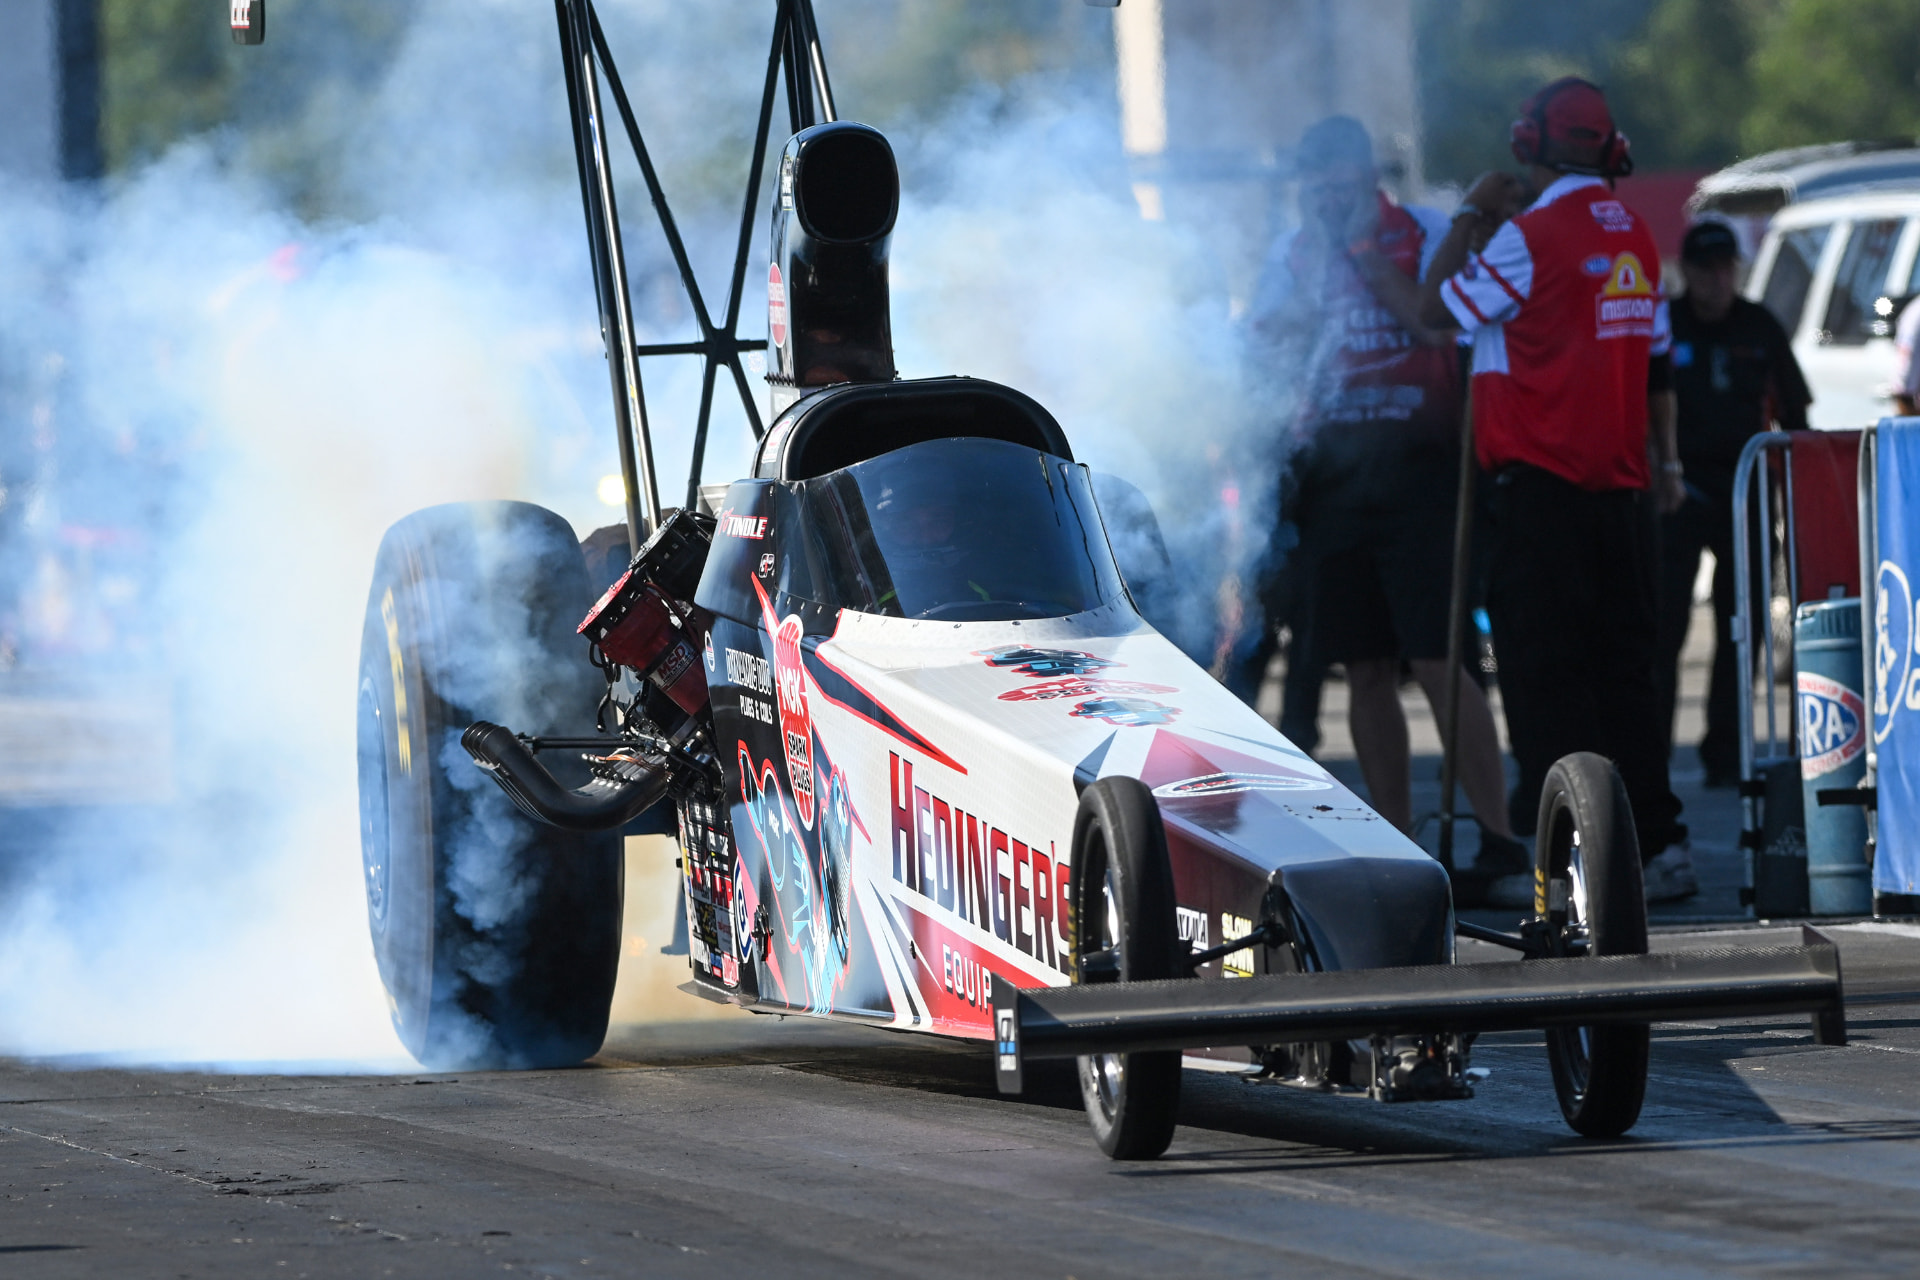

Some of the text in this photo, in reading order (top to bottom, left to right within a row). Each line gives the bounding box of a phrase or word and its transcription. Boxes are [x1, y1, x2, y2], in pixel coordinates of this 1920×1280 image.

[727, 515, 768, 539] TINDLE
[657, 645, 686, 680] MSD
[779, 665, 804, 719] NGK
[787, 731, 808, 762] SPARK
[791, 763, 811, 795] PLUGS
[1222, 912, 1252, 941] SLOW
